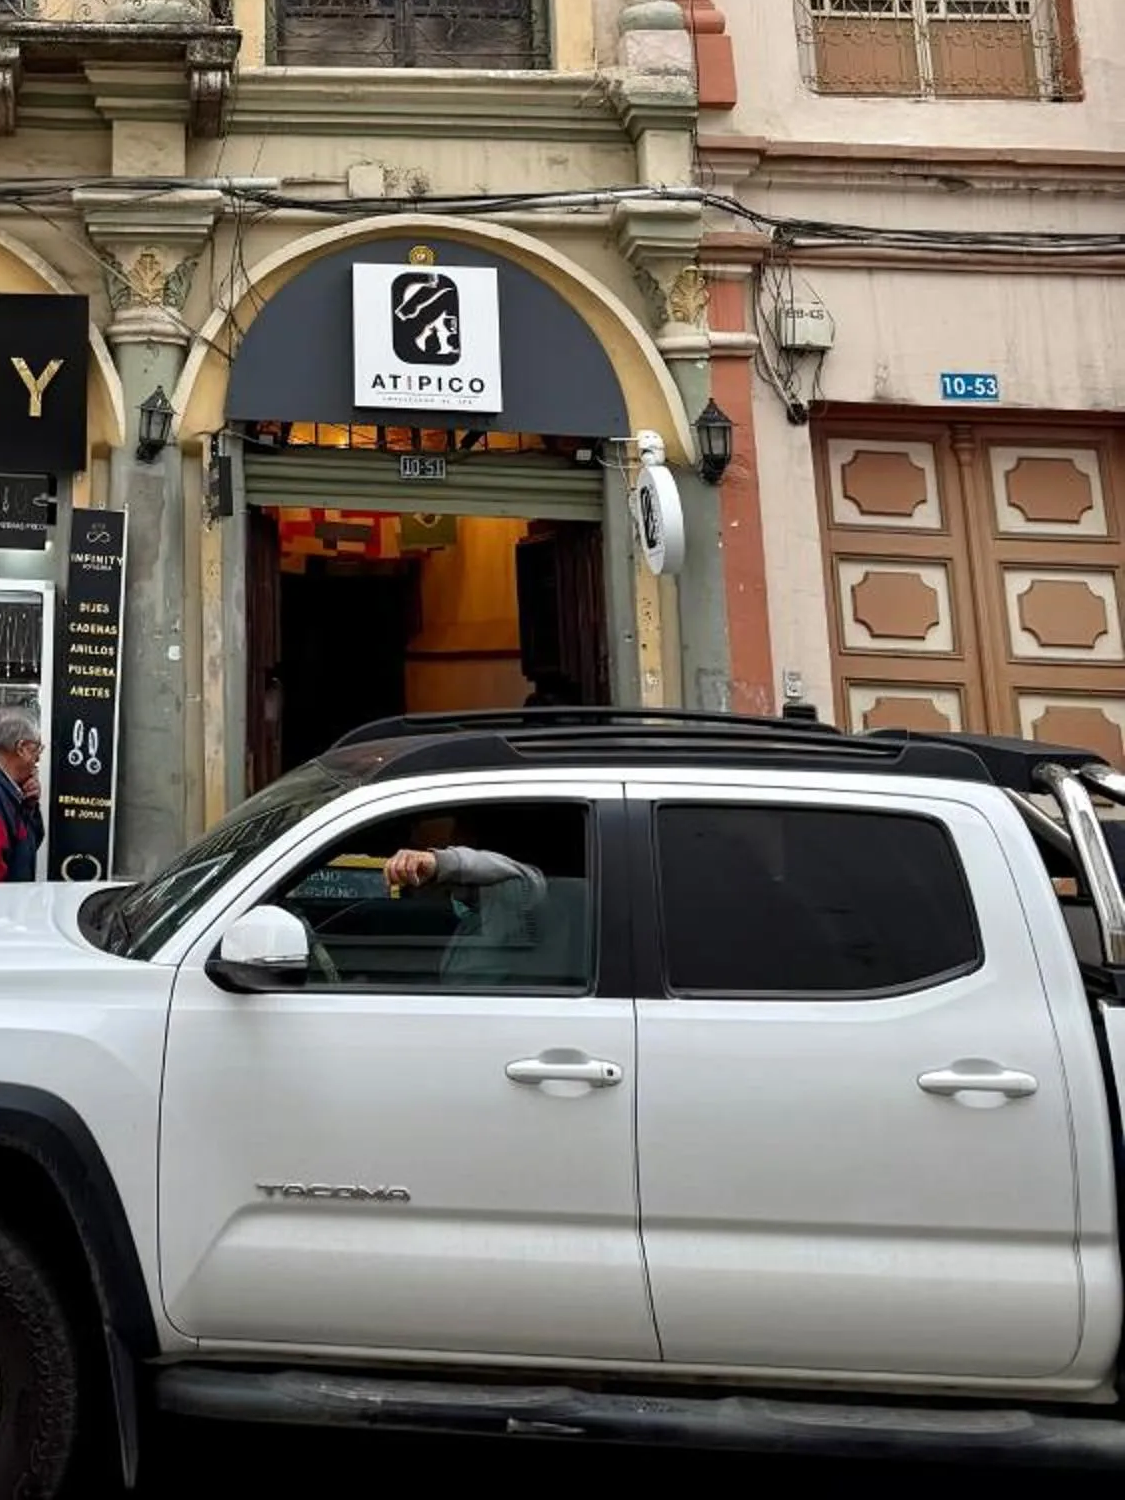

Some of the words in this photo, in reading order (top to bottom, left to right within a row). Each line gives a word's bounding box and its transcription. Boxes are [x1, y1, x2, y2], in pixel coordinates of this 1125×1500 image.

[371, 373, 486, 394] ATIPICO
[942, 376, 999, 396] 10-53
[78, 602, 110, 613] DIJES
[69, 622, 118, 635] CADENAS
[69, 643, 115, 656] ANILLOS
[69, 685, 111, 699] ARETES
[255, 1182, 412, 1203] TACOMA
